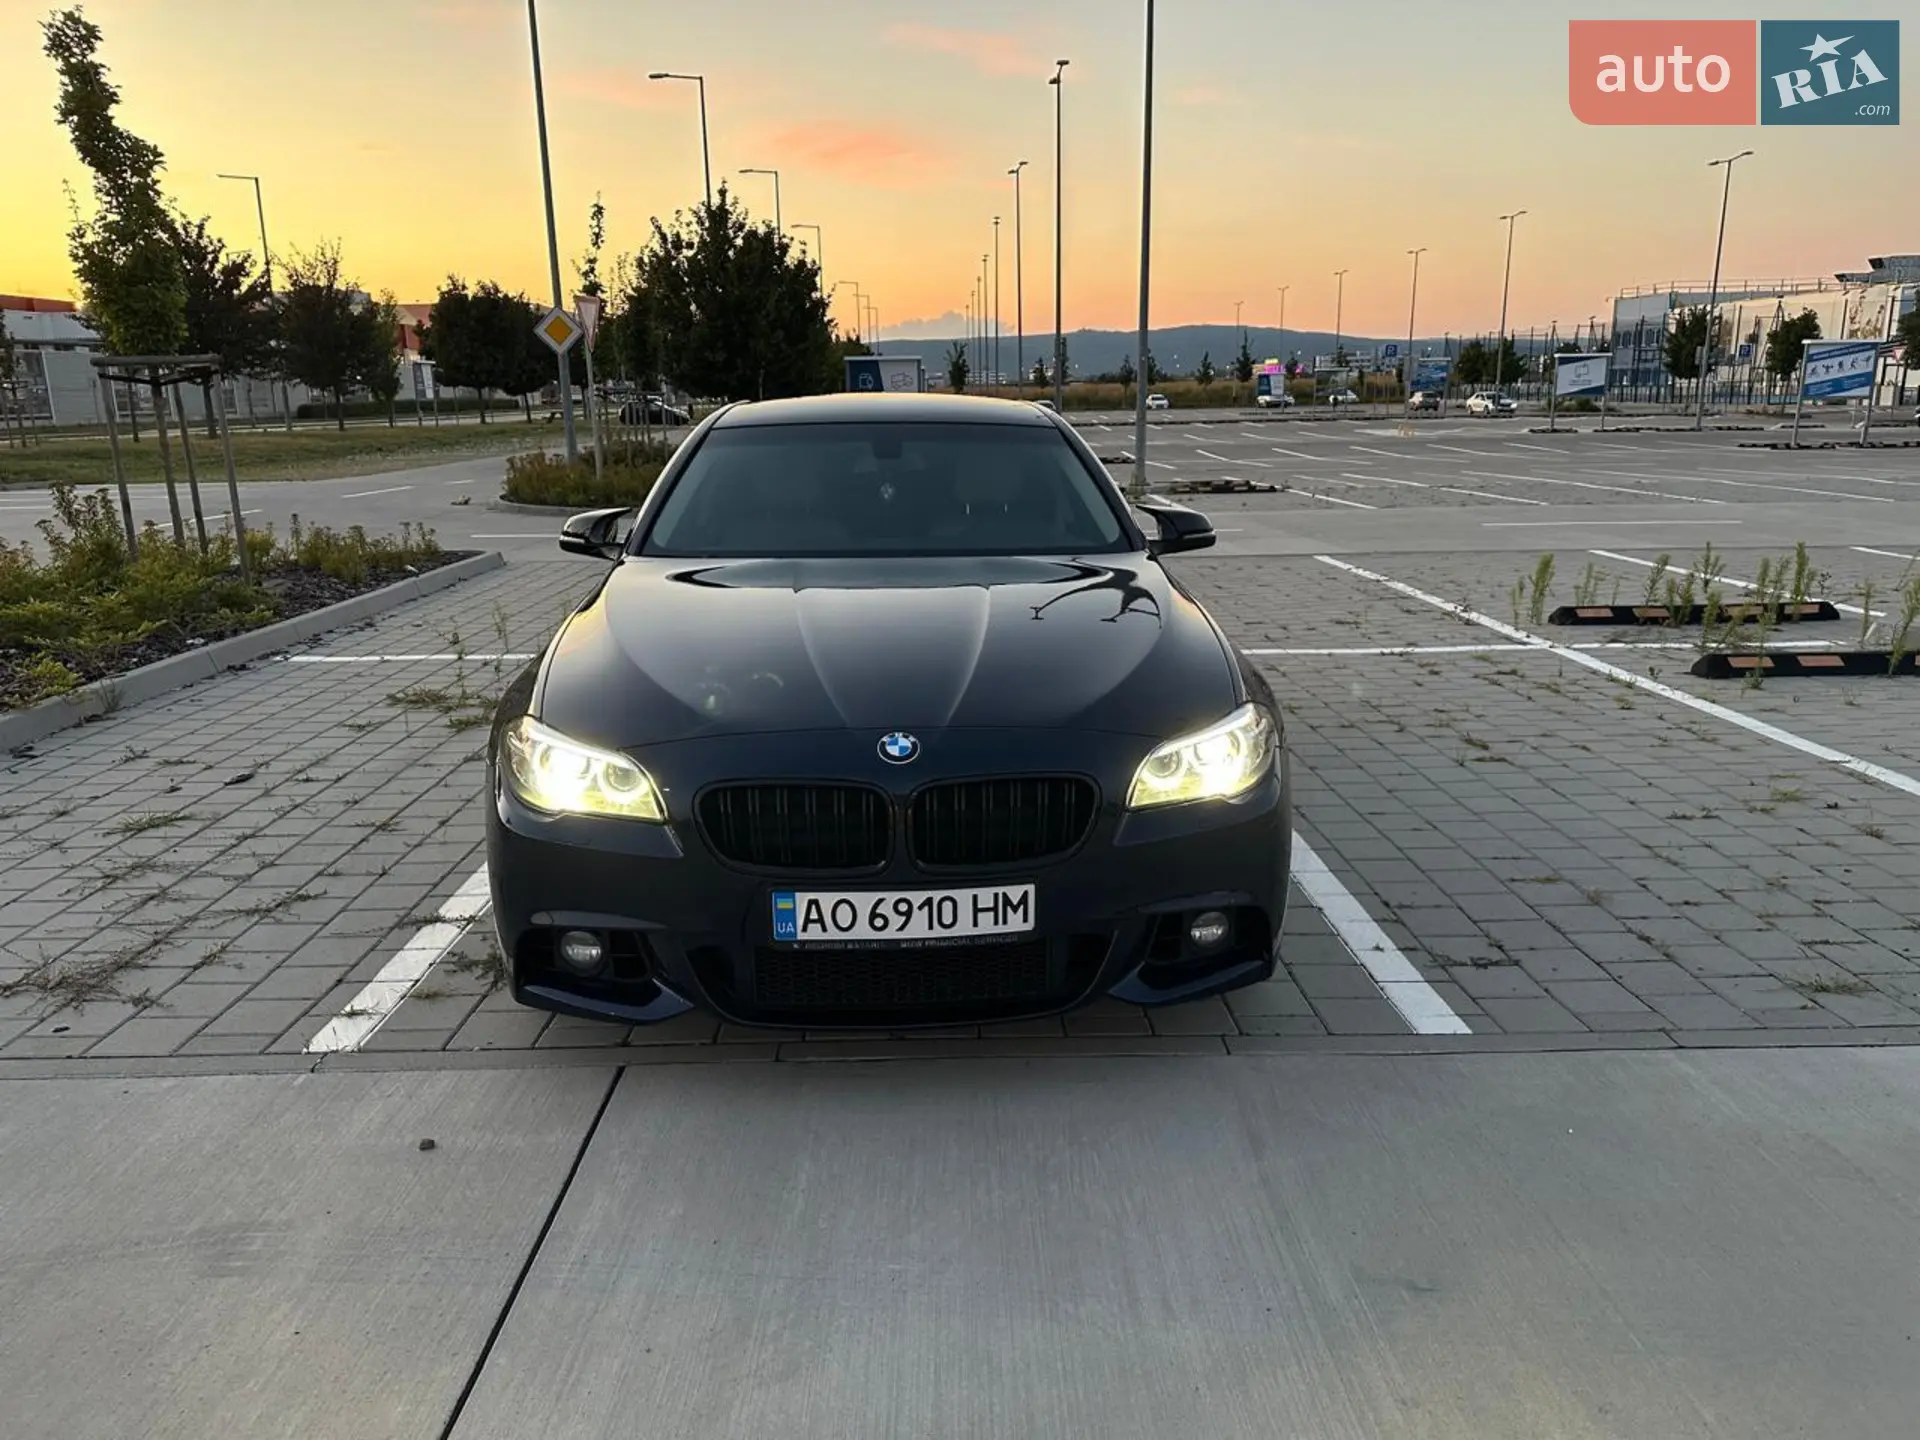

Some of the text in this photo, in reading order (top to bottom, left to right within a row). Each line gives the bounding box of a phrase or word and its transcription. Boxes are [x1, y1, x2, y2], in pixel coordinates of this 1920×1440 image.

[801, 889, 1029, 933] AO 6910 HM
[777, 923, 795, 934] UA
